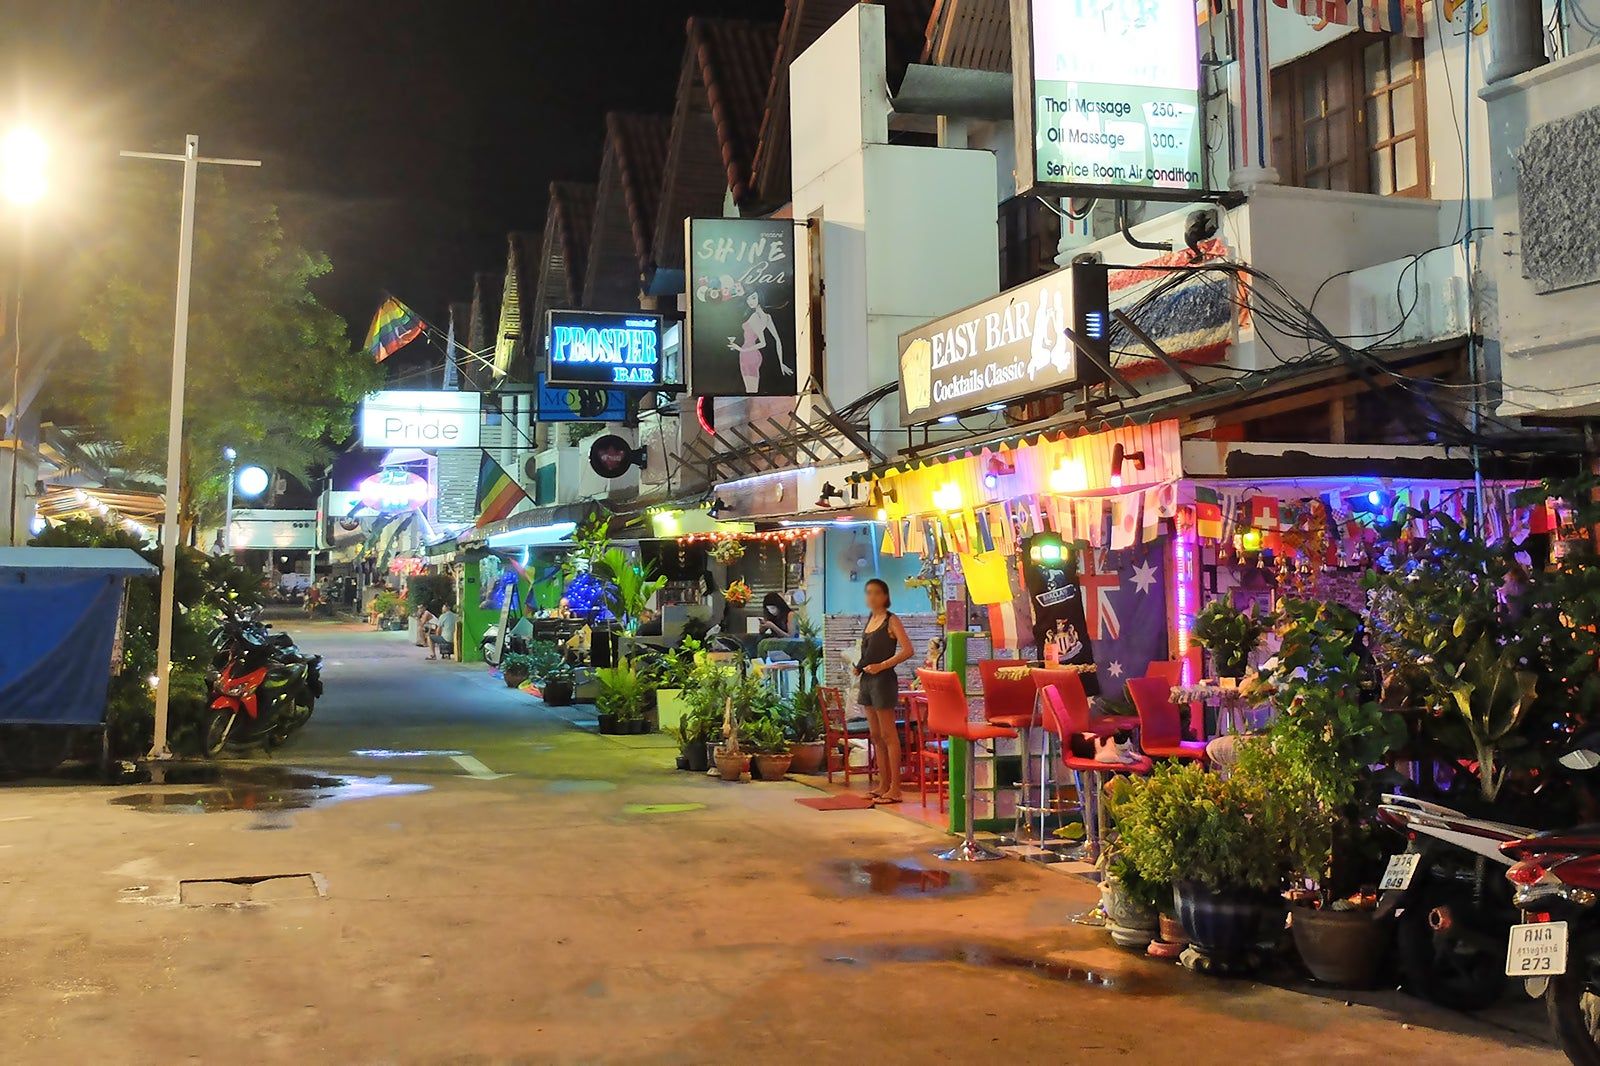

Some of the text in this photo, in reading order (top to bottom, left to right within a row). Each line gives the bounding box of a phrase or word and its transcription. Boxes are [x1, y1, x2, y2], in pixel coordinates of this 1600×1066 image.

[1045, 97, 1183, 118] Thai Massage 250.-
[1047, 128, 1183, 149] Oil Massage 300.-
[1046, 161, 1199, 184] Service Room Air condition
[697, 237, 786, 263] SHINE
[738, 260, 786, 284] Bar
[552, 326, 659, 365] PROSPER
[930, 301, 1033, 370] EASY BAR
[612, 366, 655, 383] BAR
[933, 355, 1025, 403] Cocktails Classic
[385, 417, 459, 440] Pride
[1521, 957, 1551, 971] 273
